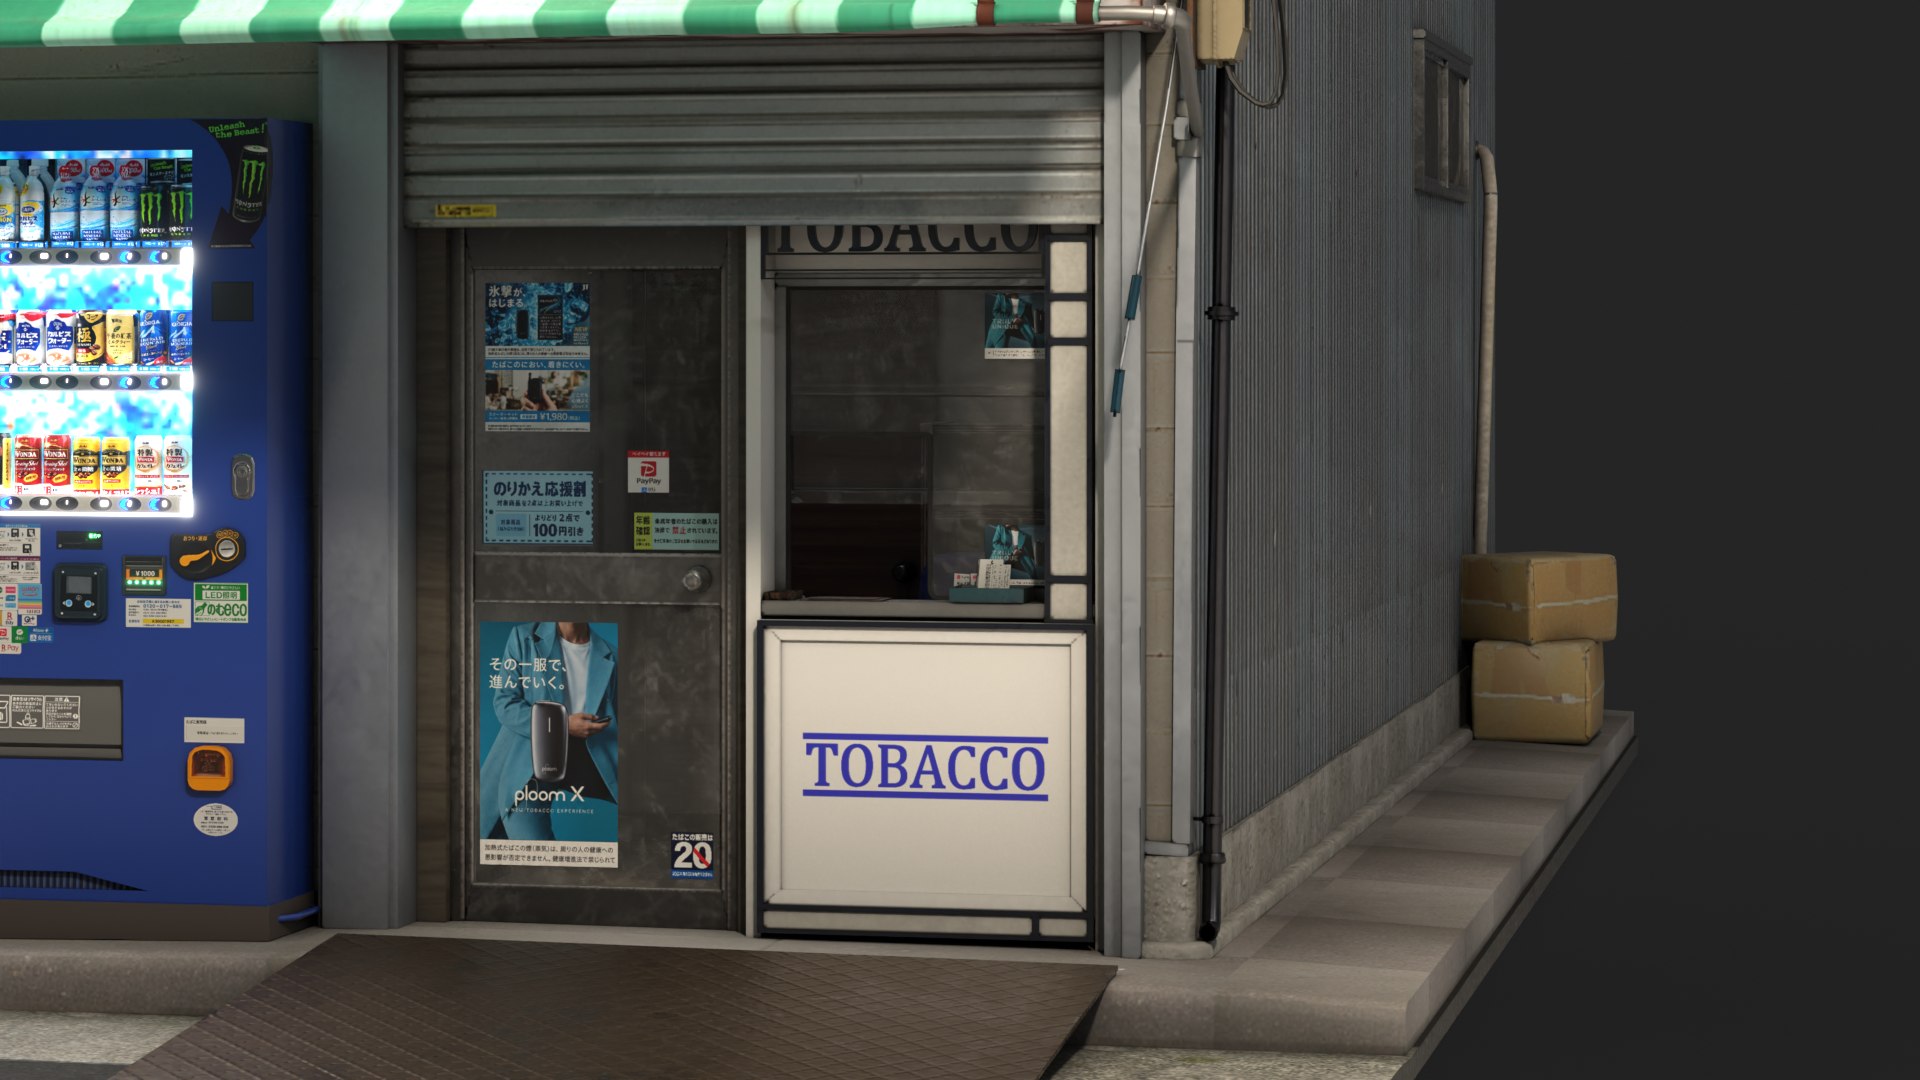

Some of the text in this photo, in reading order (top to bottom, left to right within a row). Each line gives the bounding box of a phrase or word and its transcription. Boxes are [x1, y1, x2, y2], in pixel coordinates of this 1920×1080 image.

[208, 121, 246, 134] Unleash
[215, 131, 233, 139] the
[488, 298, 524, 308] はじまる
[540, 412, 568, 421] ¥1,980
[137, 448, 153, 456] 特製
[166, 448, 183, 456] 特製
[636, 477, 662, 485] PayPay
[493, 481, 587, 498] のりかえ応援割
[533, 523, 584, 537] 100円引き
[205, 591, 238, 599] LED照明
[207, 603, 247, 617] のむeco
[489, 657, 567, 672] その一服で、
[489, 674, 565, 690] 進んでいく。
[805, 743, 1046, 791] TOBACCO
[514, 784, 585, 807] ploom X
[671, 833, 714, 841] たばこの販売は
[673, 841, 713, 870] 20
